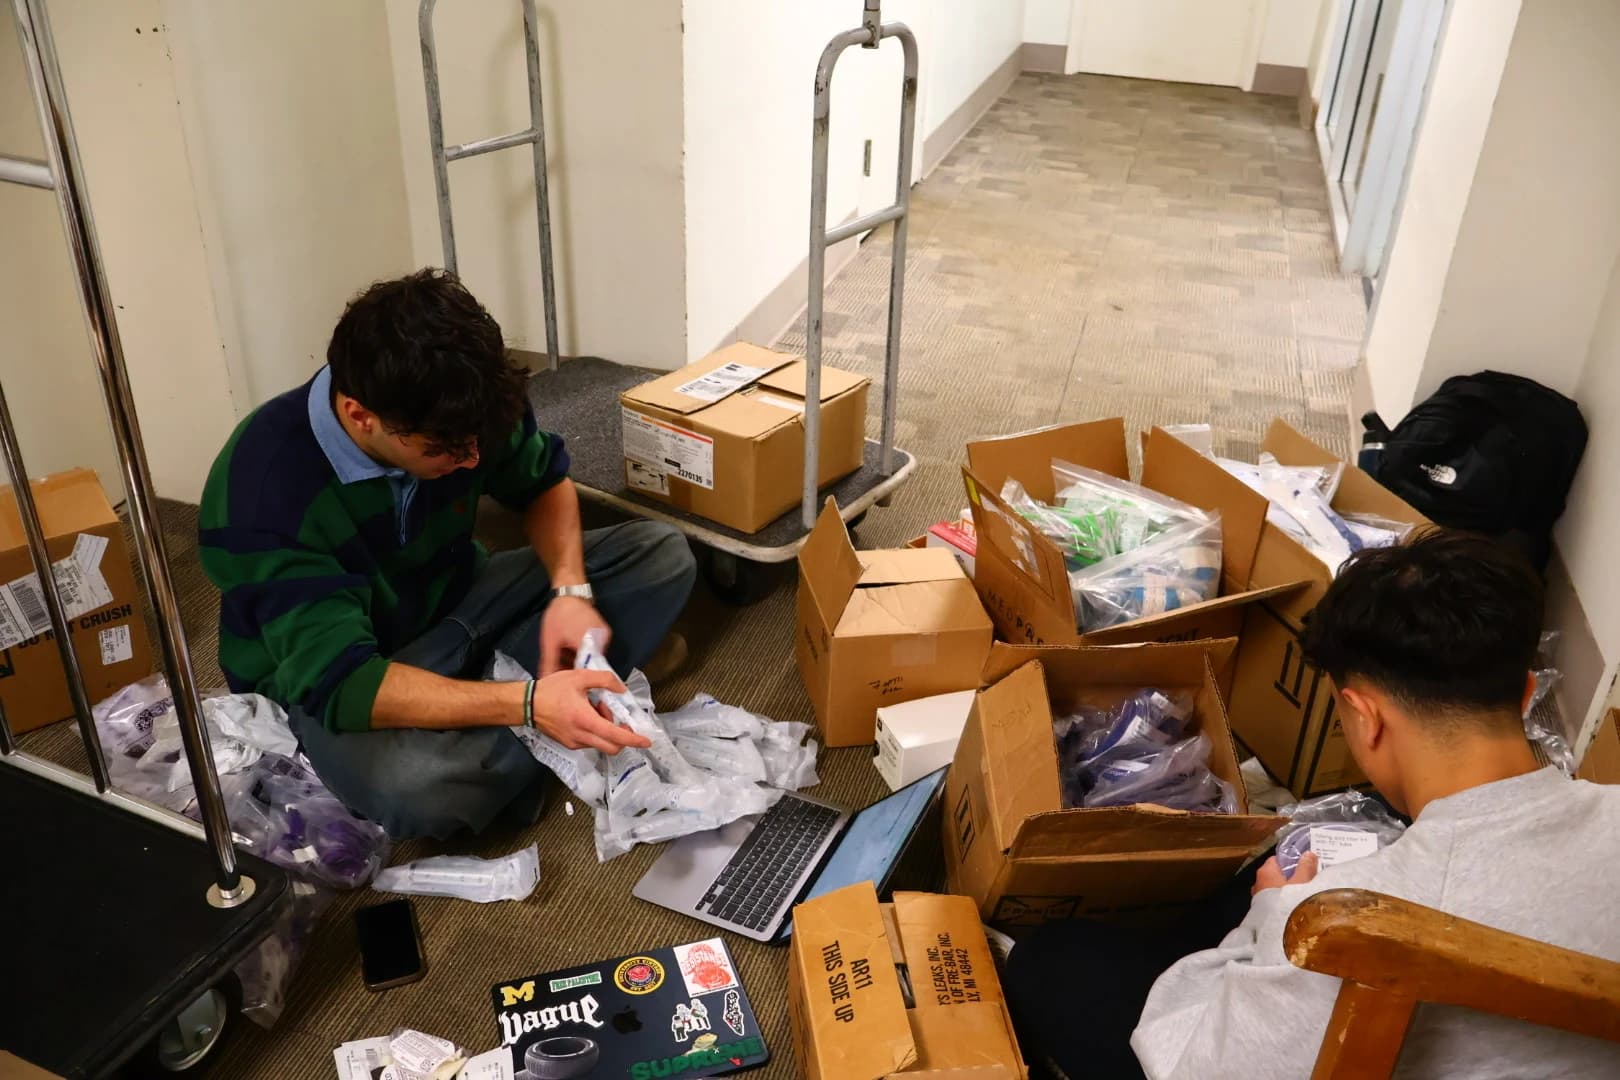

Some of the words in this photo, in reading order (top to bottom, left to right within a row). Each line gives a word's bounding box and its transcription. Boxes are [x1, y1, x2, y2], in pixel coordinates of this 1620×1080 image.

[80, 604, 132, 629] CRUSH
[822, 940, 844, 972] THIS
[926, 946, 941, 962] INC.
[955, 948, 973, 976] 48442
[850, 958, 874, 990] AR11
[963, 979, 977, 989] MI
[500, 981, 535, 1006] M
[828, 972, 851, 1005] SIDE
[950, 987, 964, 998] OF
[834, 1003, 855, 1023] UP
